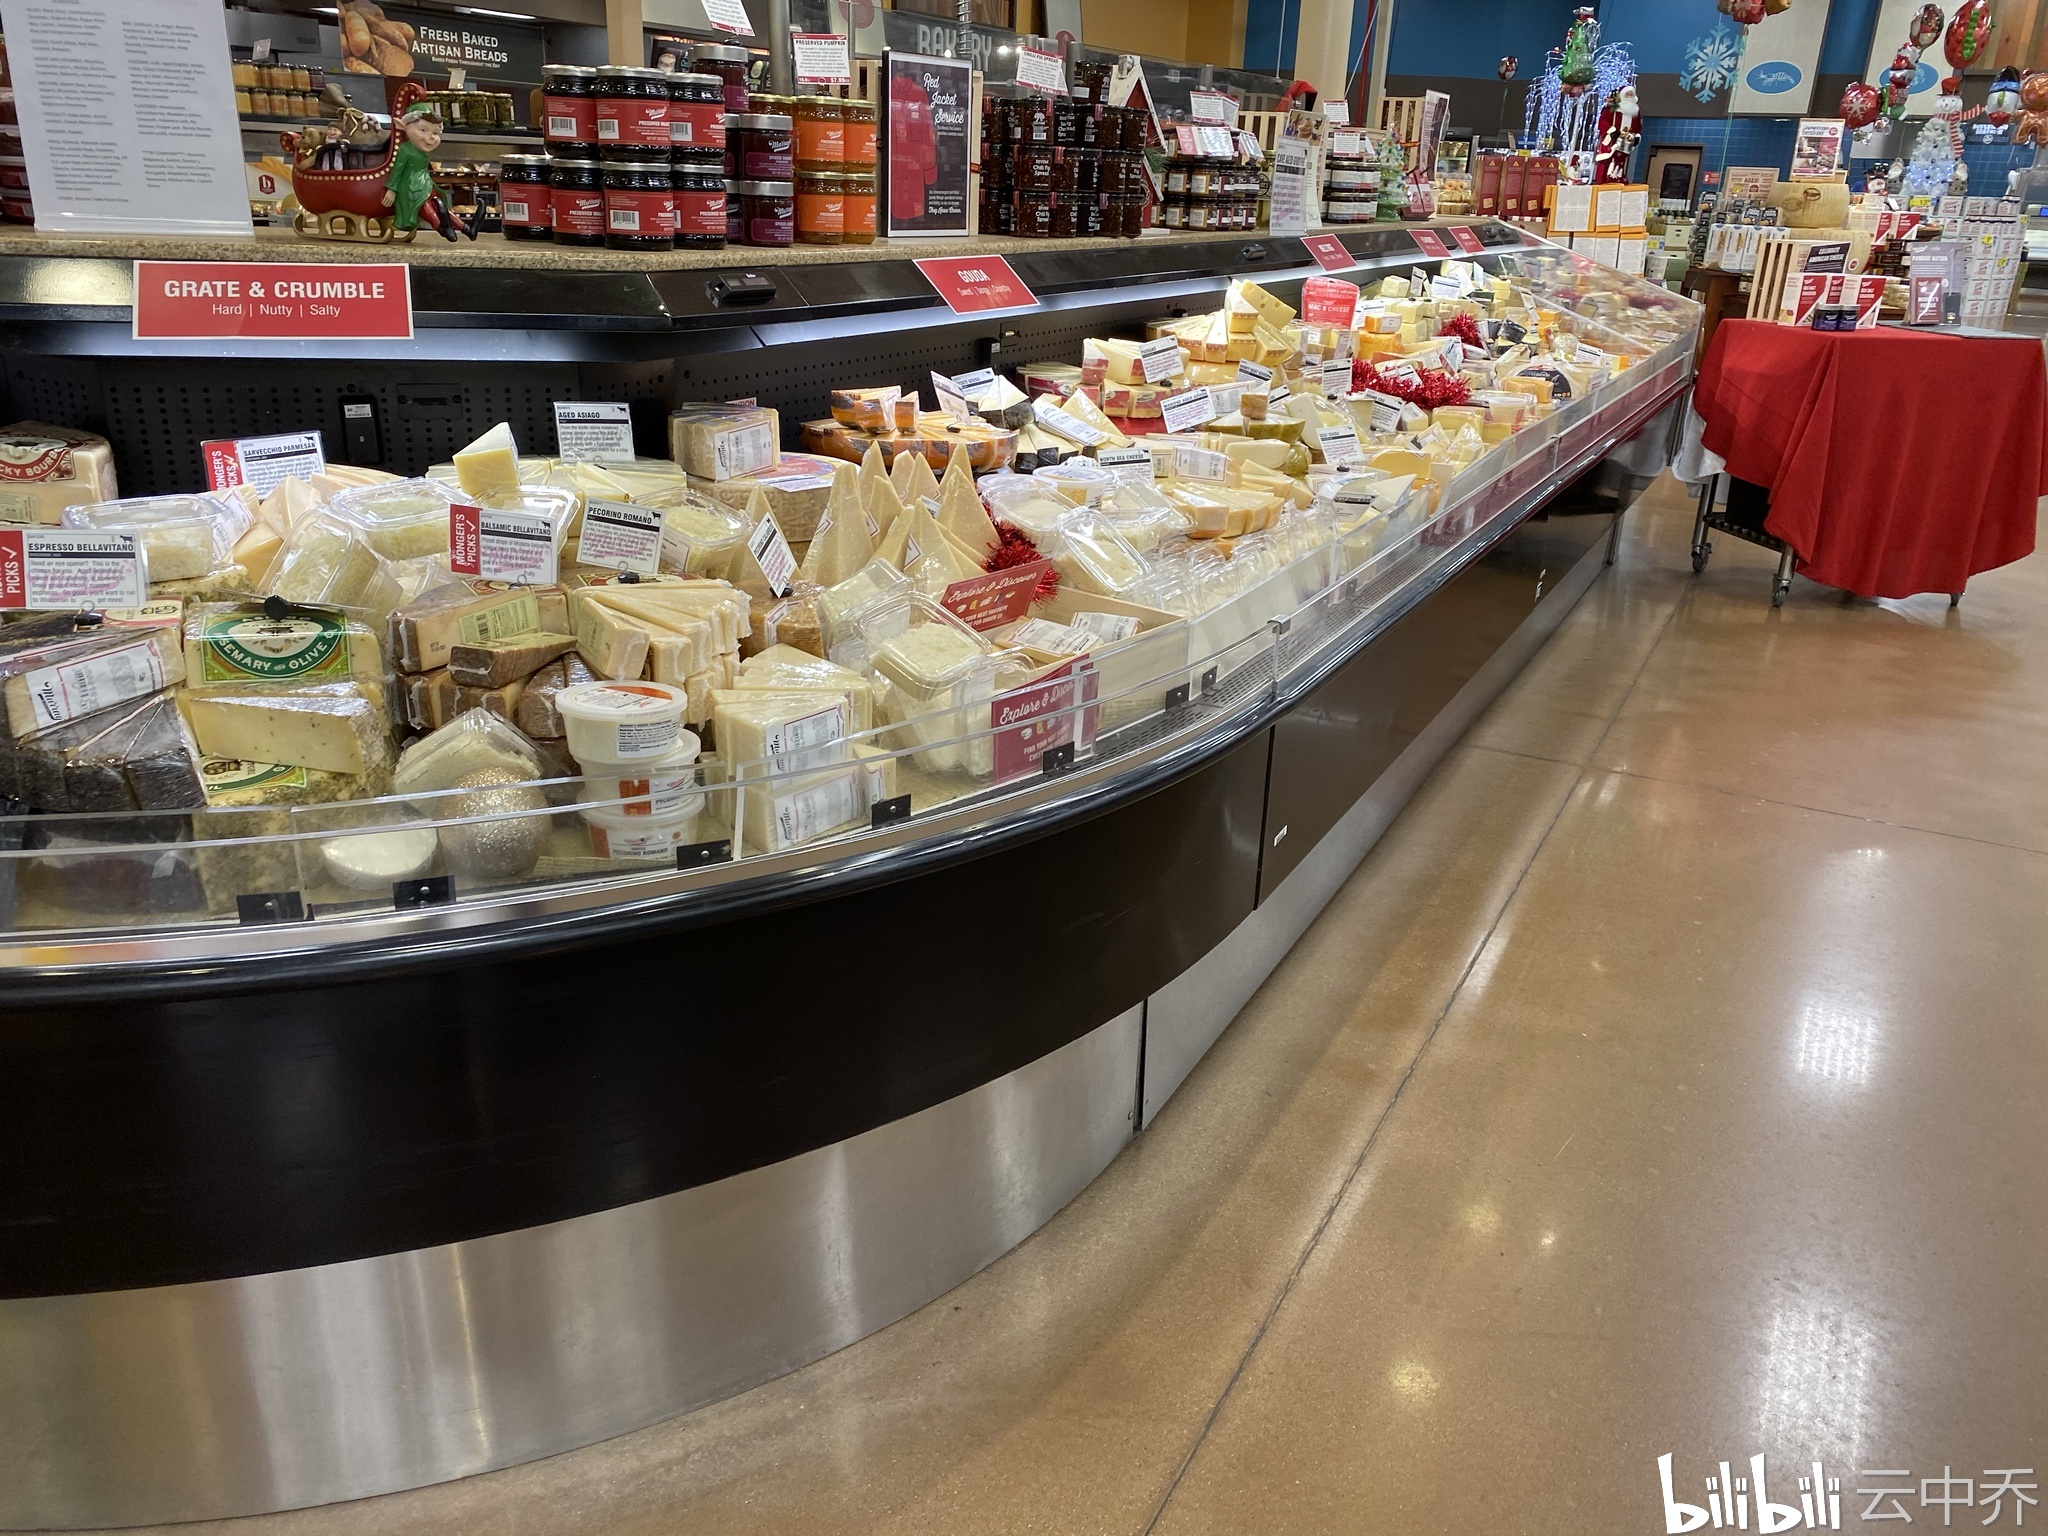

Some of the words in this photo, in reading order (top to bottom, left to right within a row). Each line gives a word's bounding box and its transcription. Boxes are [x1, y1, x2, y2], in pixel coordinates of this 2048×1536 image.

[420, 26, 458, 43] FRESH
[462, 31, 499, 48] BAKED
[412, 40, 461, 58] ARTISAN
[465, 46, 508, 63] BREADS
[916, 24, 992, 72] BAKRY
[923, 72, 940, 92] Red
[930, 91, 957, 108] Jacket
[934, 110, 964, 125] Service
[1828, 254, 1844, 262] CHEESE
[957, 268, 991, 283] GOUDA
[164, 280, 241, 298] GRATE
[248, 280, 266, 298] &
[274, 281, 386, 299] CRUMBLE
[956, 287, 974, 296] Sweet
[974, 286, 991, 295] Tangy
[992, 284, 1012, 294] Crunchy
[212, 304, 242, 316] Hard
[260, 304, 293, 318] Nutty
[310, 304, 341, 318] Salty
[244, 446, 282, 457] SARVECCHIO
[284, 442, 316, 452] PARMESAN
[25, 450, 58, 477] BOURB
[212, 450, 225, 491] ONGER'S
[226, 465, 238, 489] ICKS
[588, 507, 622, 518] PECORINO
[623, 513, 652, 524] ROMANO
[481, 521, 511, 532] BALSAMIC
[513, 525, 551, 535] BELLAVITANO
[29, 543, 74, 551] ESPRESSO
[77, 543, 134, 551] BELLAVITANO
[456, 513, 465, 566] MONGER'S
[467, 534, 476, 563] PICKS
[5, 561, 20, 594] PICKS
[948, 586, 986, 604] Explore
[996, 572, 1038, 590] Discover
[989, 604, 1008, 615] FAVORITE
[217, 637, 271, 671] SEMARY
[288, 642, 328, 669] OLIVE
[1000, 702, 1040, 725] Explore
[1042, 692, 1050, 706] &
[1023, 743, 1036, 755] FIND
